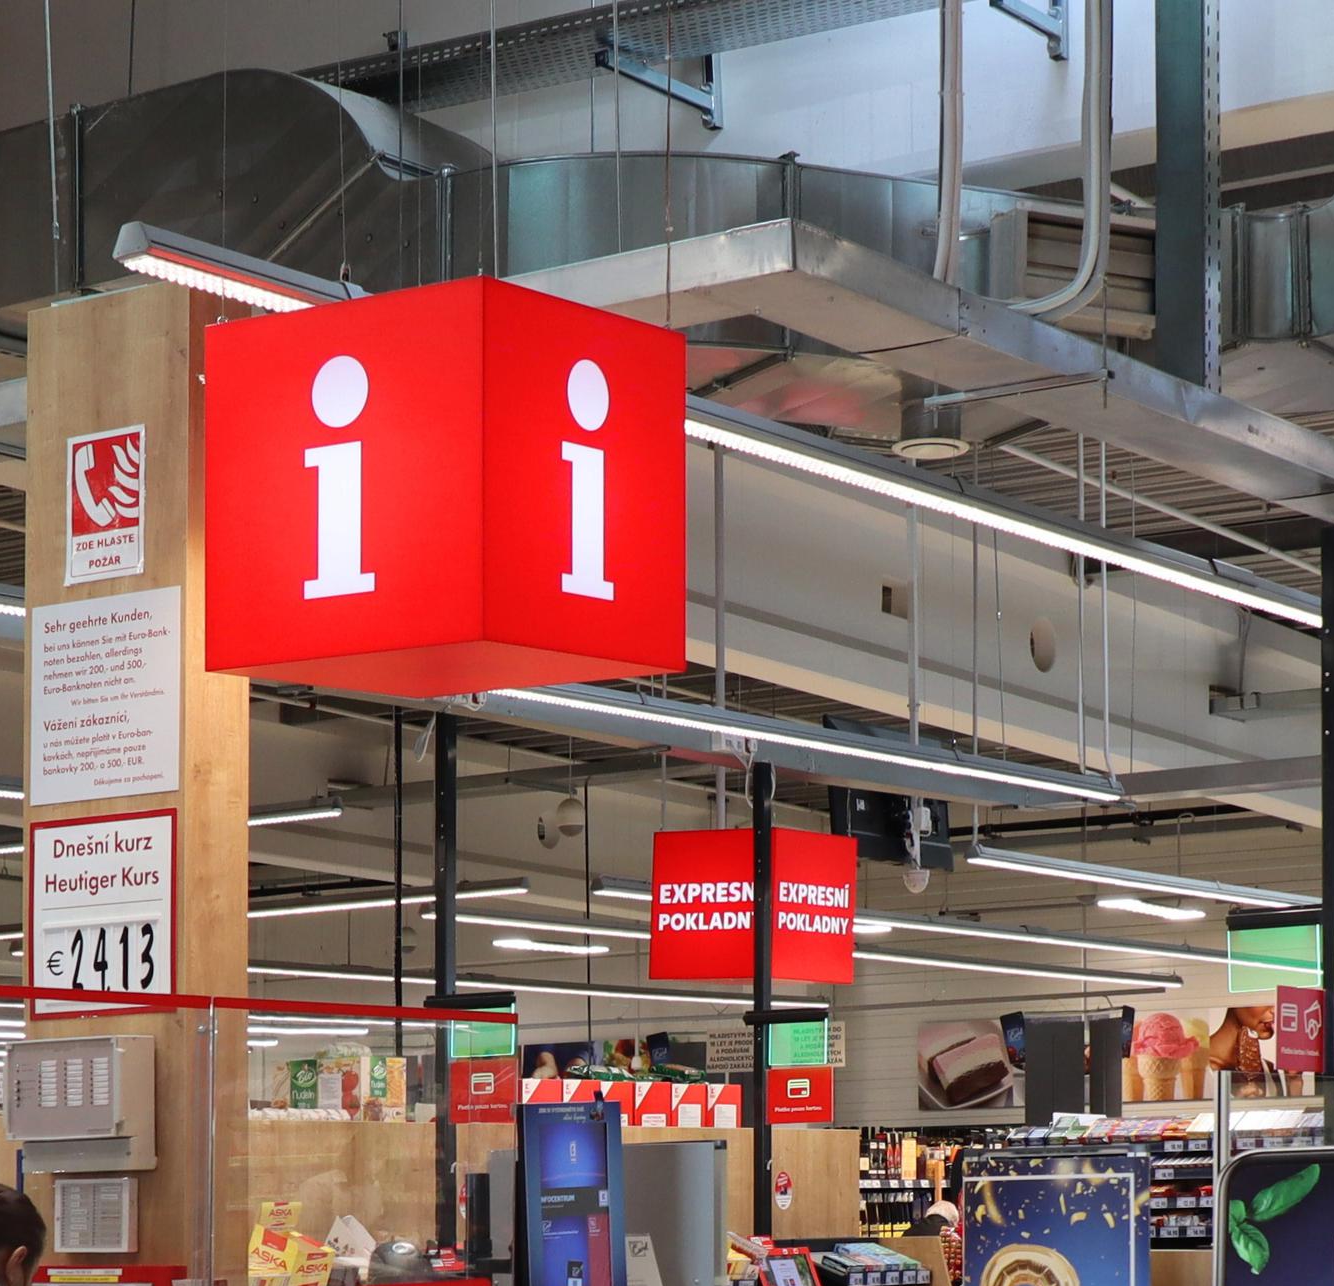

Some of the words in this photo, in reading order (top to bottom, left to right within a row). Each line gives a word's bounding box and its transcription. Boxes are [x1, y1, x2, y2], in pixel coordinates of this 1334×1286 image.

[76, 540, 94, 552] ZDE
[97, 534, 135, 548] HLASTE
[44, 620, 66, 634] Sehr
[69, 614, 108, 633] geehrte
[110, 608, 153, 624] Kunden,
[43, 643, 55, 653] bei
[57, 642, 70, 651] uns
[72, 638, 100, 649] können
[102, 635, 113, 645] Sie
[114, 633, 126, 643] mit
[128, 626, 171, 641] Euro-Bank-
[43, 656, 65, 667] noten
[66, 652, 103, 664] bezahlen,
[105, 646, 143, 659] allerdings
[43, 669, 73, 681] nehmen
[75, 667, 87, 676] wir
[110, 661, 125, 672] und
[43, 681, 103, 695] Euro-Banknoten
[104, 676, 122, 687] nicht
[123, 677, 136, 685] an.
[43, 717, 77, 732] Vážení
[80, 710, 130, 728] zákazníci,
[43, 741, 48, 749] u
[49, 738, 63, 748] nás
[64, 735, 90, 747] můžete
[91, 732, 110, 745] platit
[111, 734, 117, 742] v
[123, 744, 147, 754] pouze
[43, 764, 78, 777] bankovky
[127, 757, 145, 767] EUR.
[53, 833, 109, 859] Dnešní
[114, 830, 153, 854] kurz
[45, 870, 117, 896] Heutiger
[122, 865, 160, 887] Kurs
[659, 881, 754, 904] EXPRESN
[779, 881, 850, 909] EXPRESNÍ
[658, 911, 754, 931] POKLADN
[778, 911, 849, 935] POKLADNY
